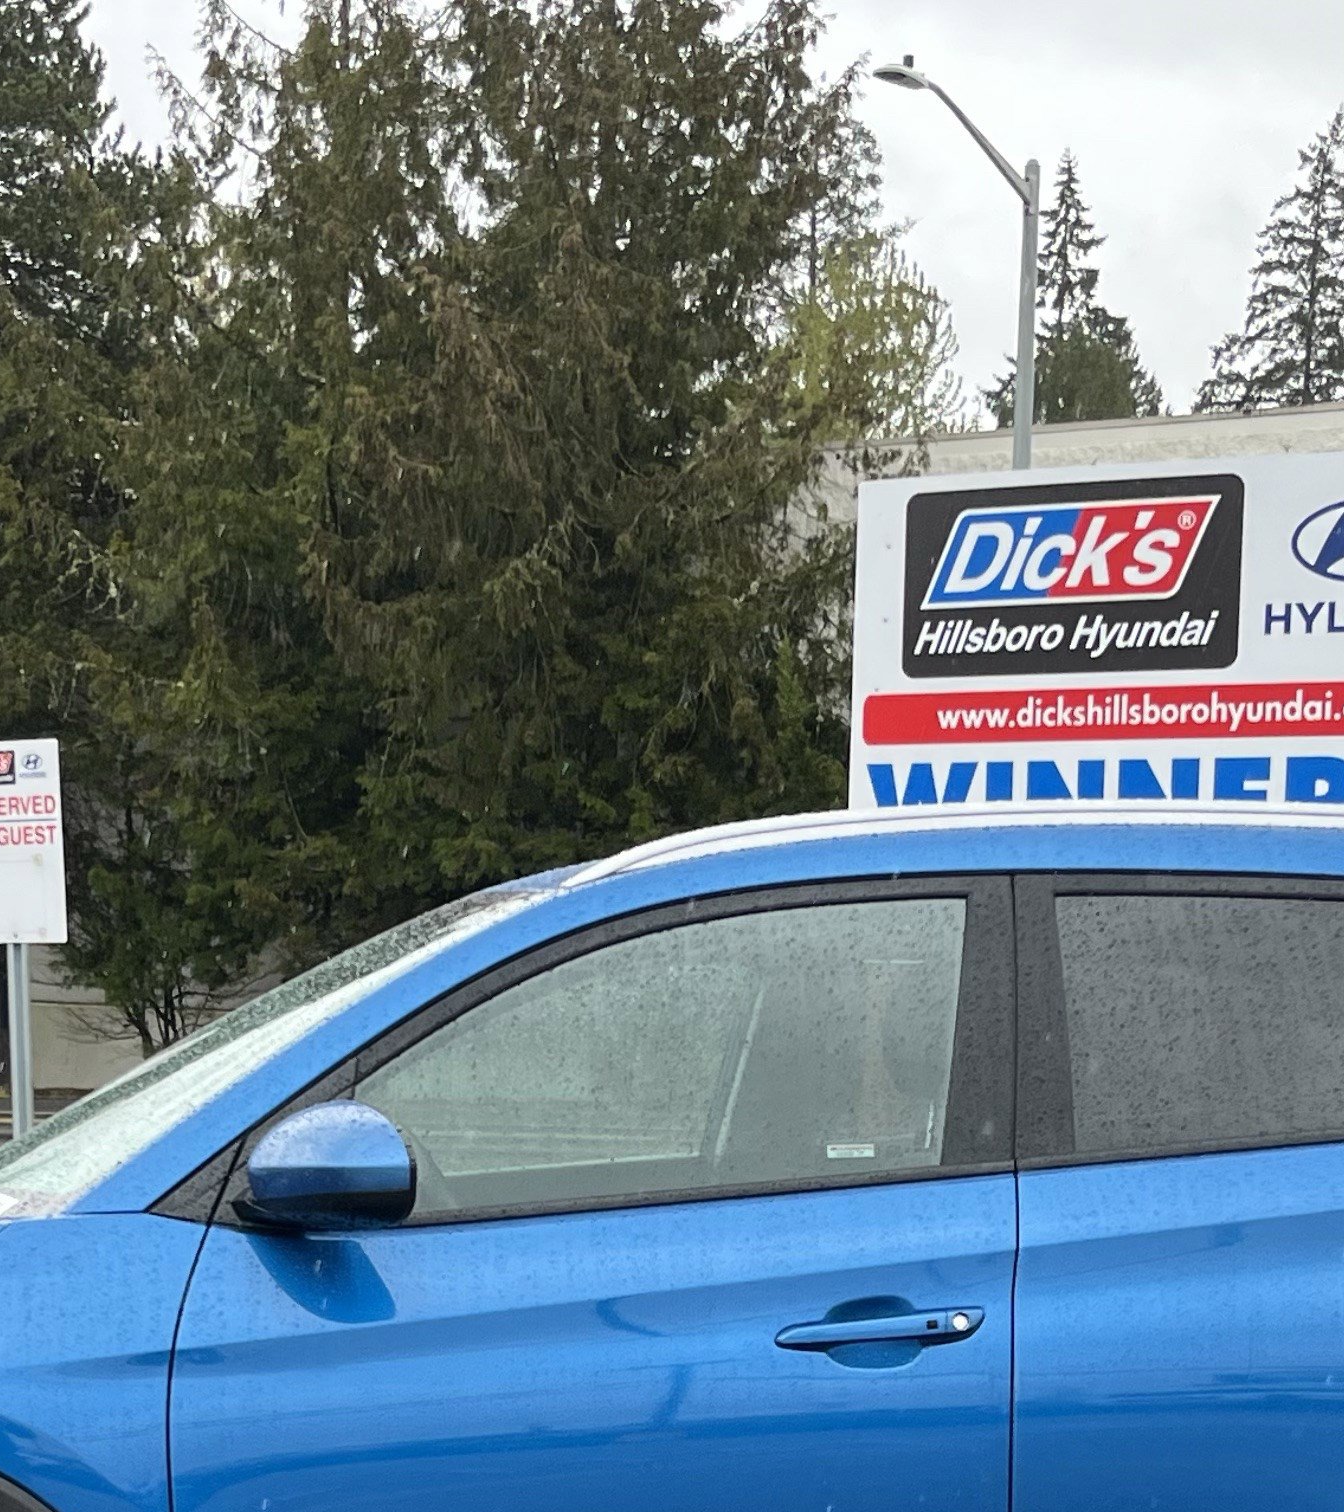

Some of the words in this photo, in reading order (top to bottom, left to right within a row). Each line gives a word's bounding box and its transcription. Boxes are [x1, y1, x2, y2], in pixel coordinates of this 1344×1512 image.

[942, 510, 1182, 595] Dick's
[913, 617, 1064, 656] Hillsboro
[1069, 609, 1221, 658] Hyundai
